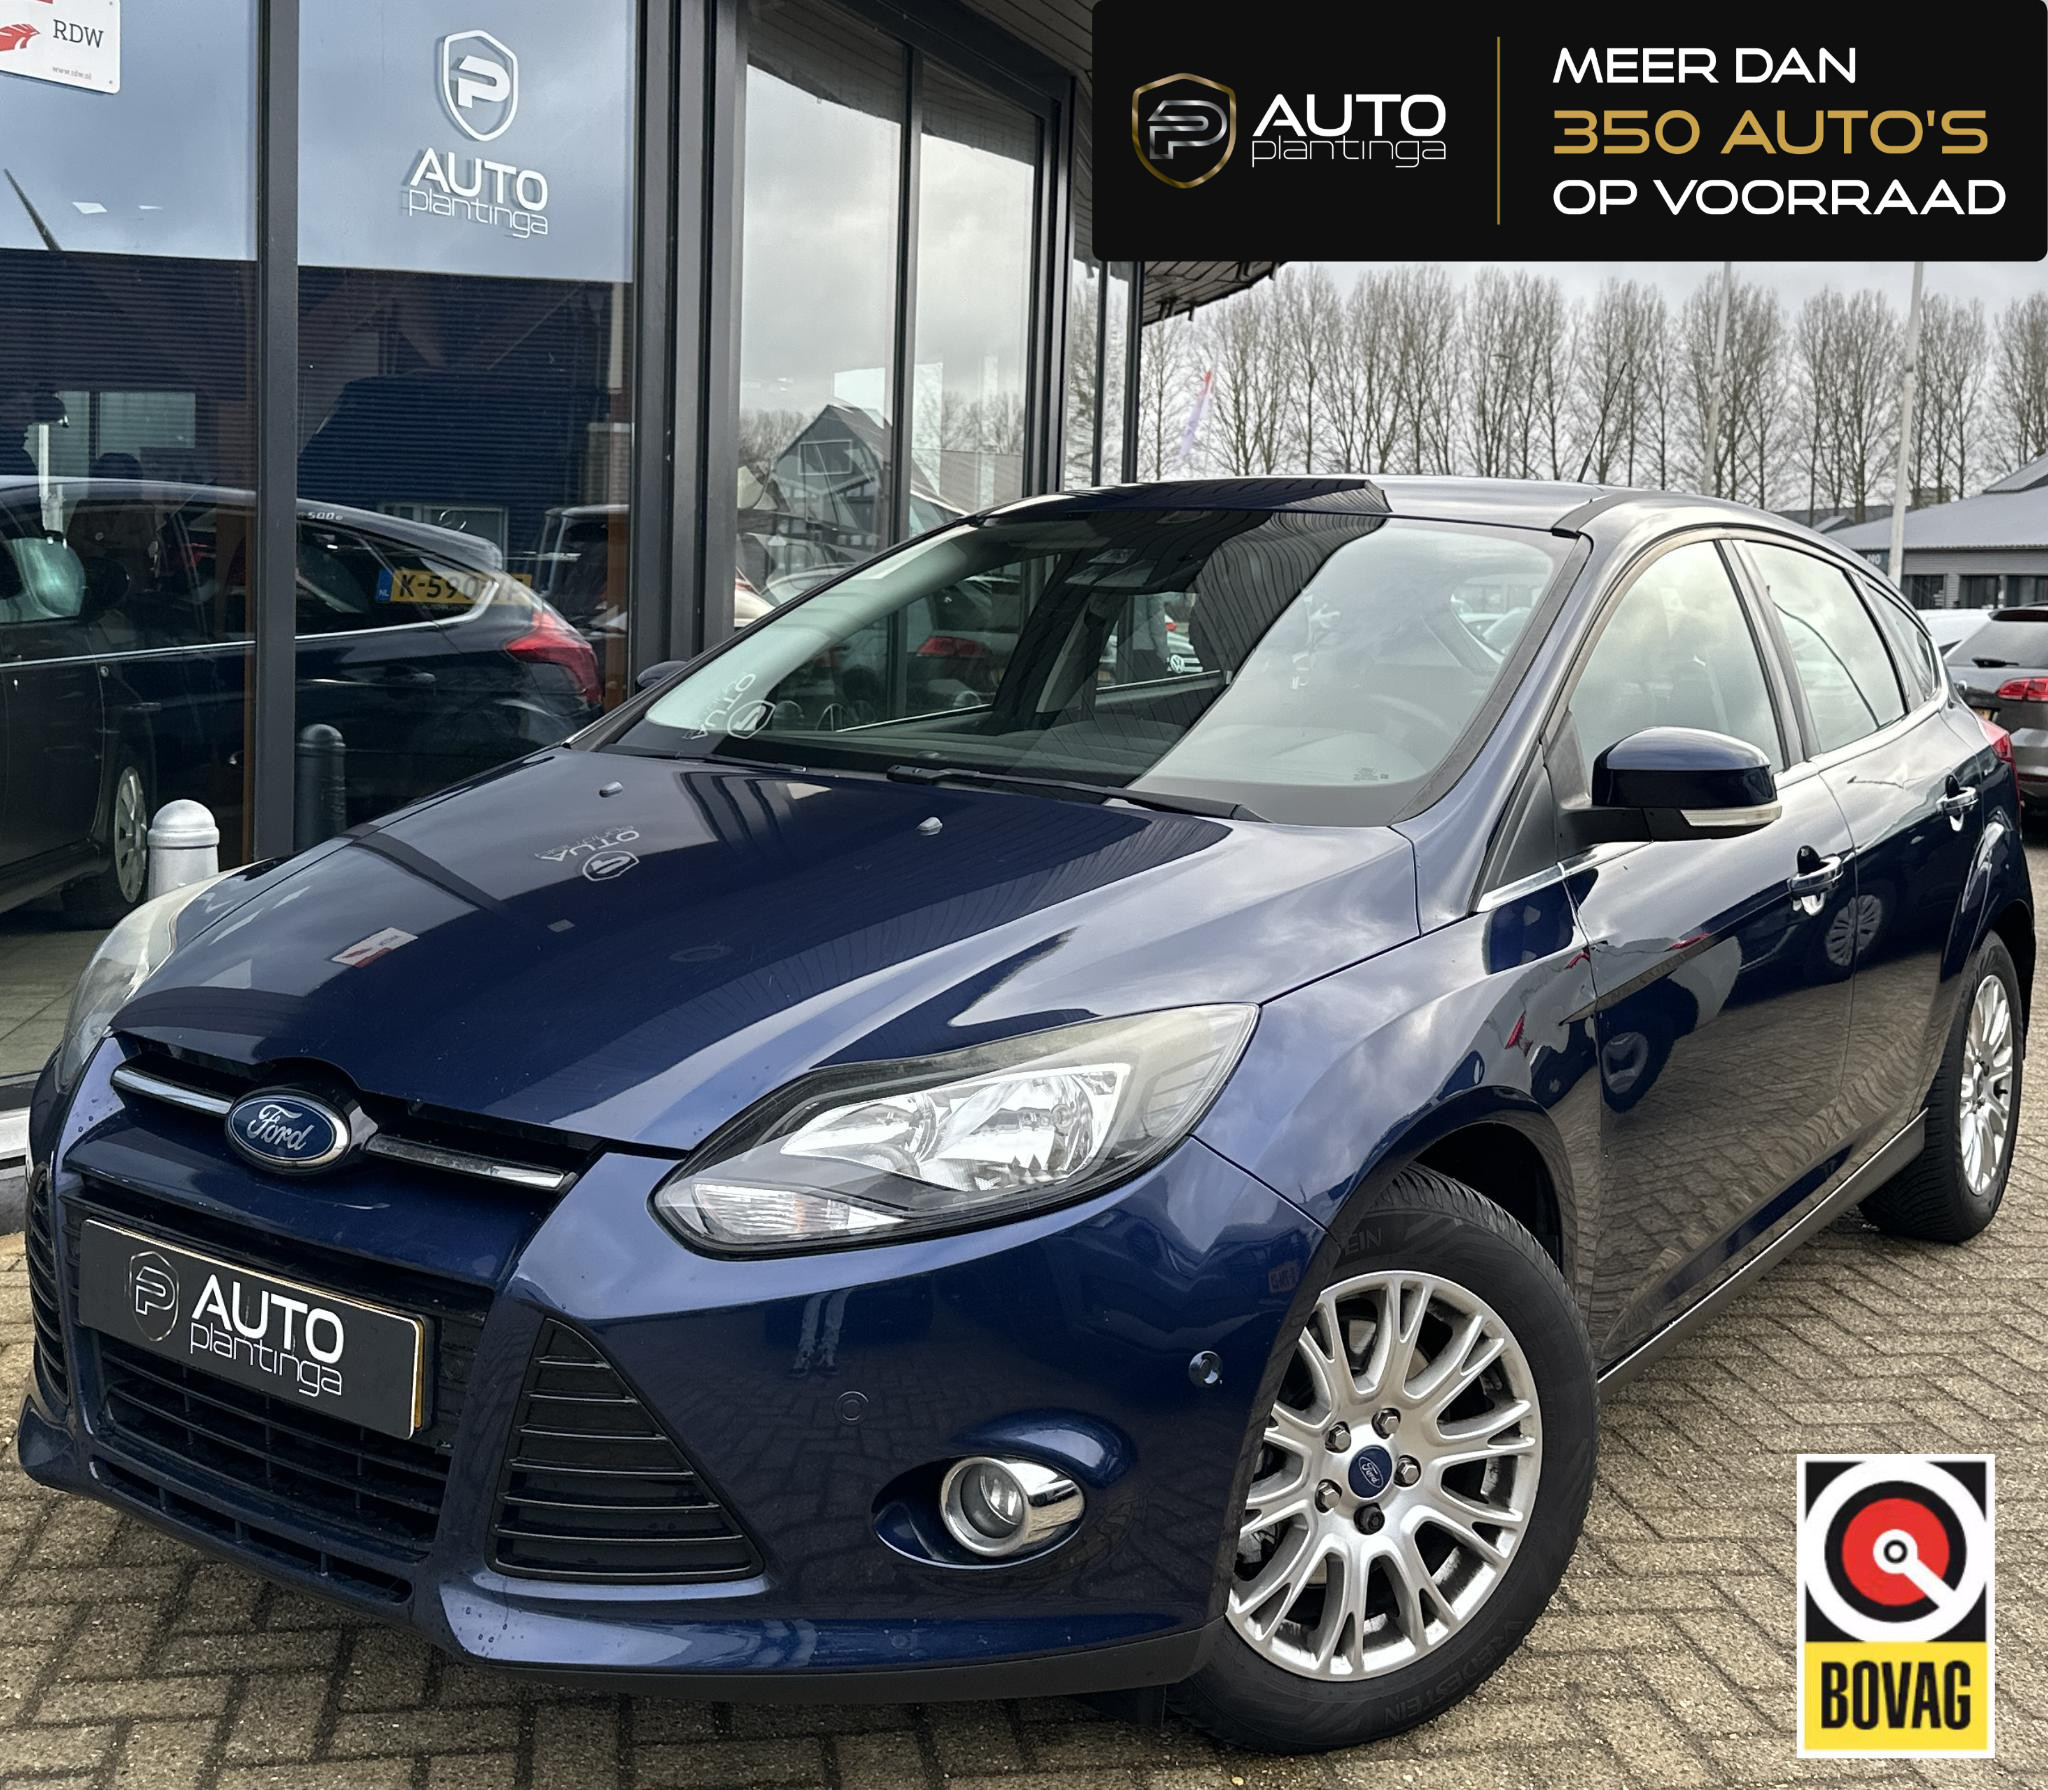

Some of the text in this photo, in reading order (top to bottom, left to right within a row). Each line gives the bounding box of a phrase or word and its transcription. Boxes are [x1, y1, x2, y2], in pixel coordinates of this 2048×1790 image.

[52, 19, 104, 48] RDW
[410, 147, 548, 211] AUTO
[409, 188, 549, 238] plantinga
[246, 1104, 315, 1151] Ford
[191, 1274, 345, 1364] AUTO
[190, 1322, 343, 1397] plantinga
